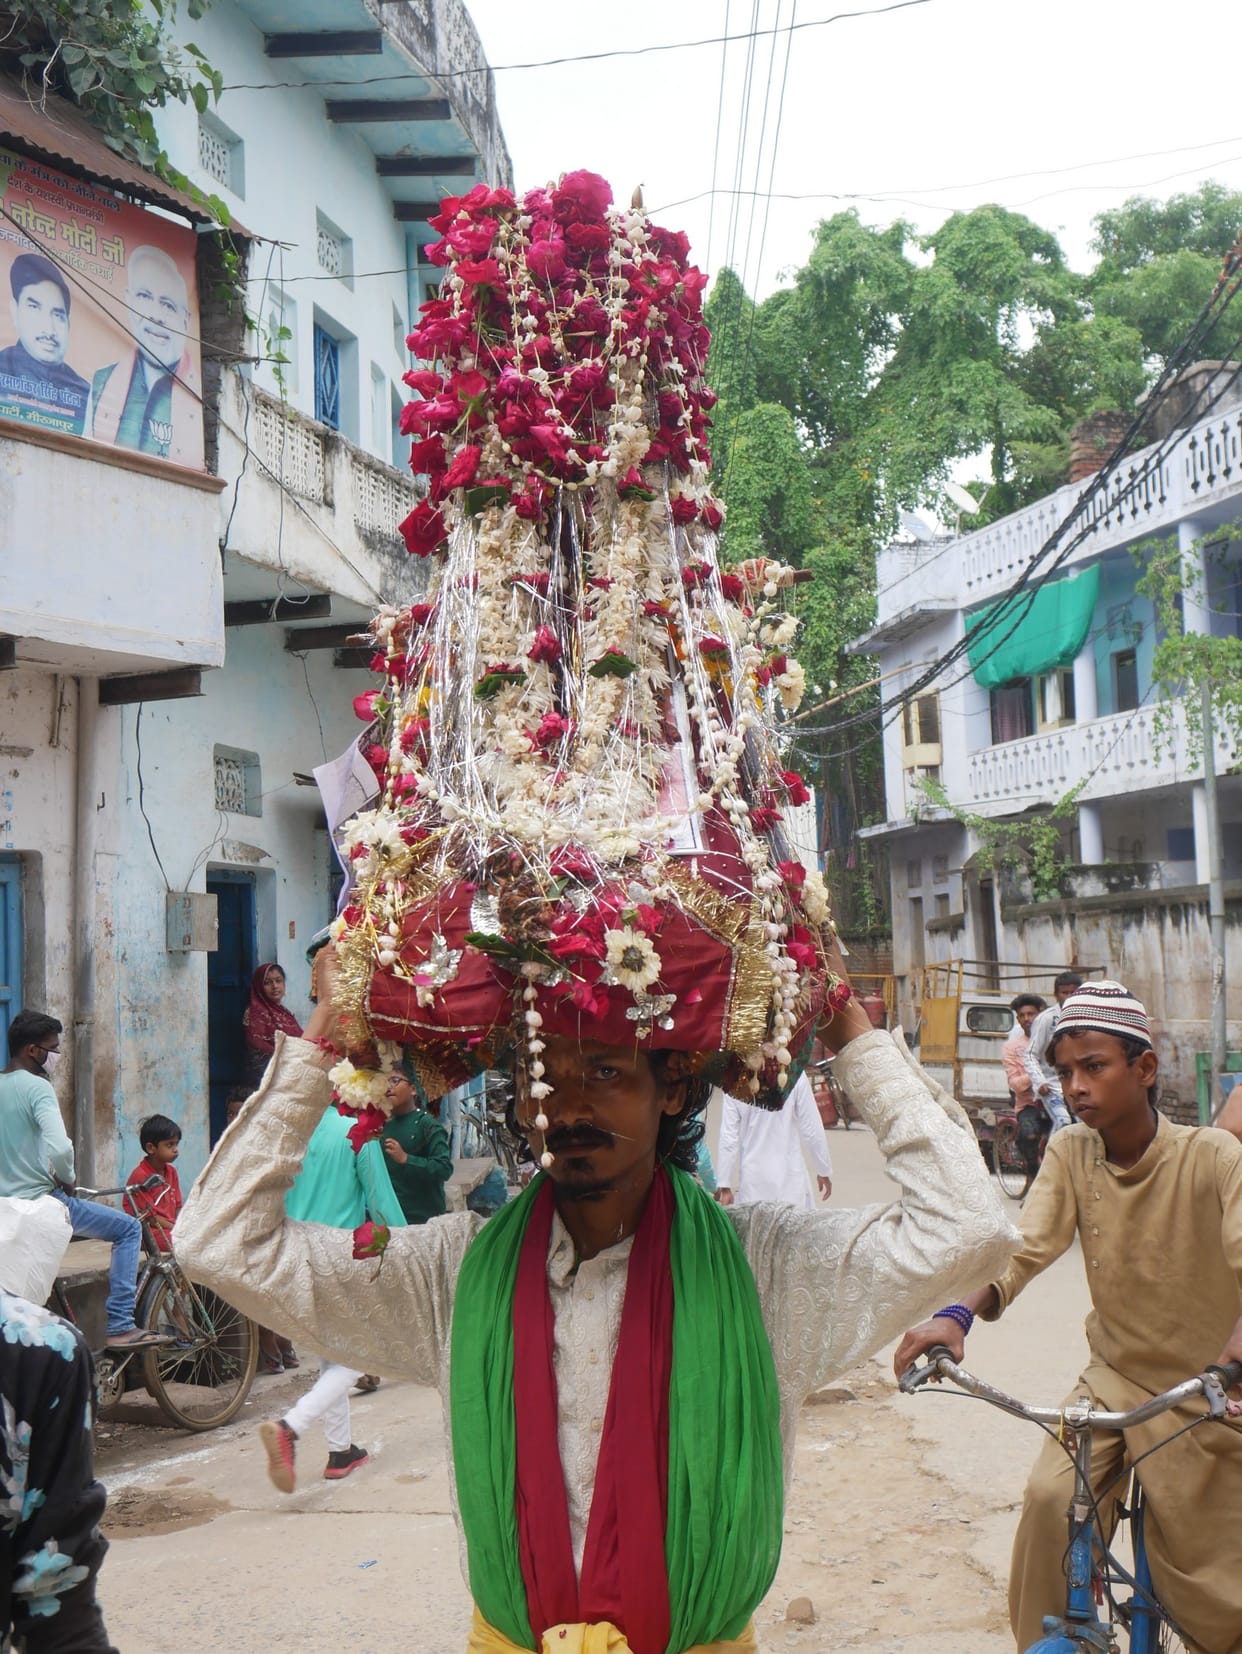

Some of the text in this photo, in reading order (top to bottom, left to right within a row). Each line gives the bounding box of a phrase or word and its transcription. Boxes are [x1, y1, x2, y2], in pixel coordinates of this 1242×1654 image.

[7, 175, 105, 223] देश के यशस्वी प्रधानमंत्री
[10, 199, 56, 240] नरेन्द्र
[61, 216, 97, 256] मोदी
[101, 235, 125, 267] जी
